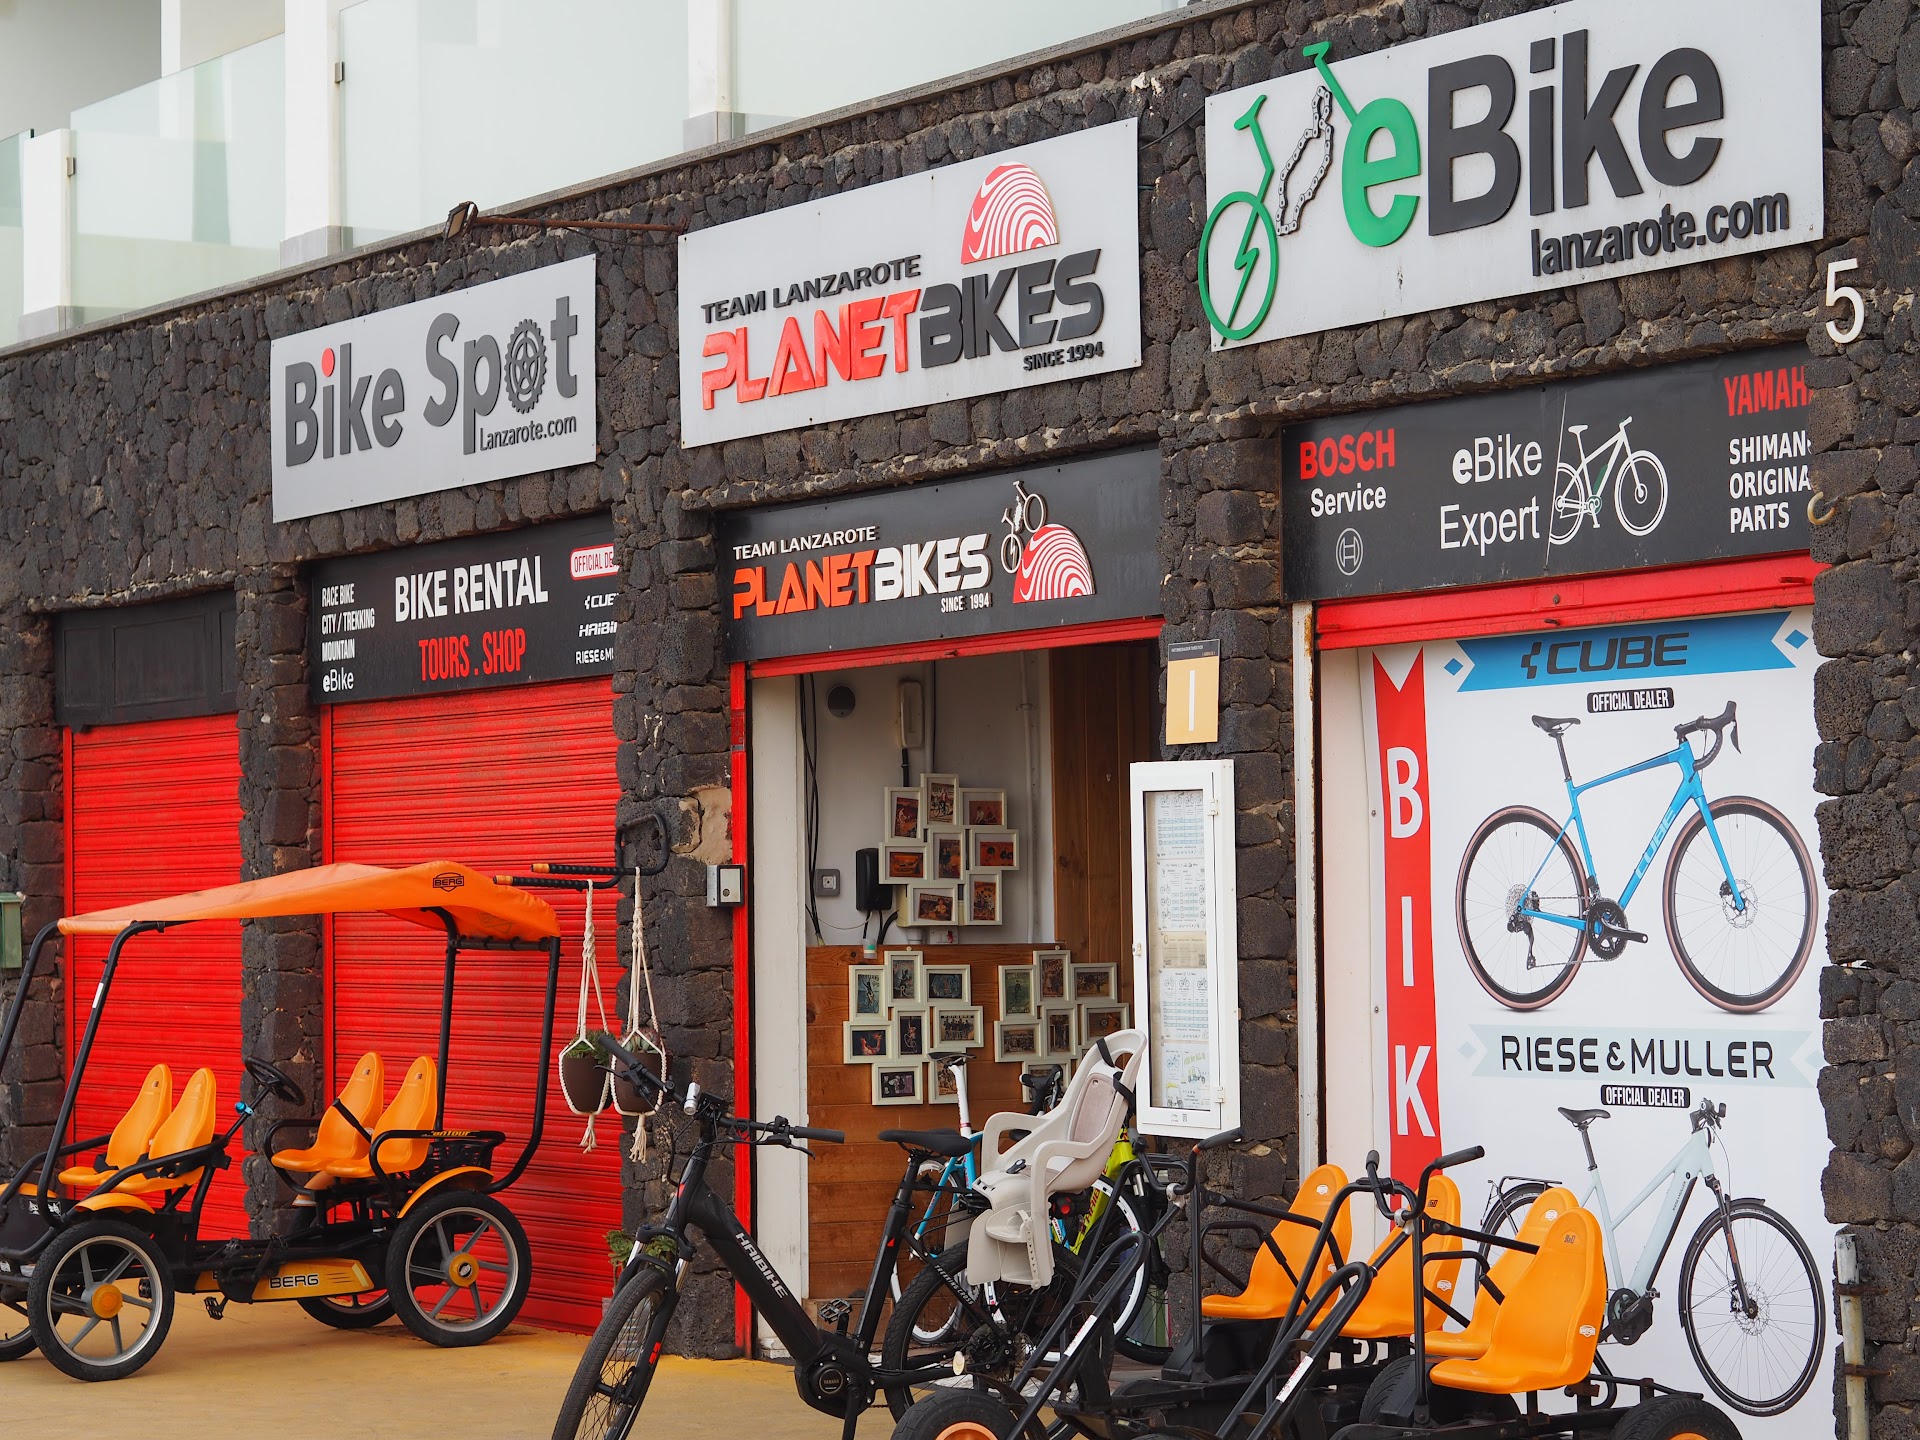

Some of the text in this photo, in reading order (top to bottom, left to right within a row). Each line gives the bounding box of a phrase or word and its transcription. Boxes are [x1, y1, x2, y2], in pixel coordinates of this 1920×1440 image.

[1342, 28, 1725, 247] eBike
[1531, 191, 1790, 277] lanzarote.com
[701, 254, 921, 324] TEAM LANZAROTE
[1825, 257, 1865, 344] 5
[1023, 341, 1104, 371] SINCE 1994
[285, 342, 405, 467] Bike
[1724, 365, 1813, 417] YAMAH
[479, 415, 577, 452] Lanzarote.com
[1729, 429, 1812, 465] SHIMAN
[1300, 427, 1396, 480] BOSCH
[1452, 433, 1543, 485] eBike
[1310, 482, 1386, 518] Service
[1730, 501, 1790, 534] PARTS
[733, 525, 879, 560] TEAM LANZAROTE
[1440, 495, 1540, 556] Expert
[574, 553, 603, 573] OFFICIAL
[322, 583, 355, 607] RACE BIKE
[395, 555, 549, 623] BIKE RENTAL
[940, 592, 990, 613] SINCE 1994
[322, 613, 337, 635] CITY
[343, 607, 375, 632] TREKKING
[322, 638, 355, 662] MOUNTAIN
[418, 634, 470, 681] TOURS
[482, 627, 526, 675] SHOP
[1546, 632, 1689, 675] CUBE
[323, 666, 354, 692] eBike
[1592, 689, 1670, 712] OFFICIAL DEALER
[1635, 806, 1676, 879] CUBE
[435, 877, 463, 886] BERG
[1501, 1035, 1601, 1072] RIESE
[1631, 1038, 1776, 1079] MULLER
[1606, 1086, 1685, 1108] OFFICIAL DEALER
[269, 1274, 320, 1289] BERG
[735, 1232, 788, 1299] HAIBIKE
[934, 1264, 958, 1289] TREKKING
